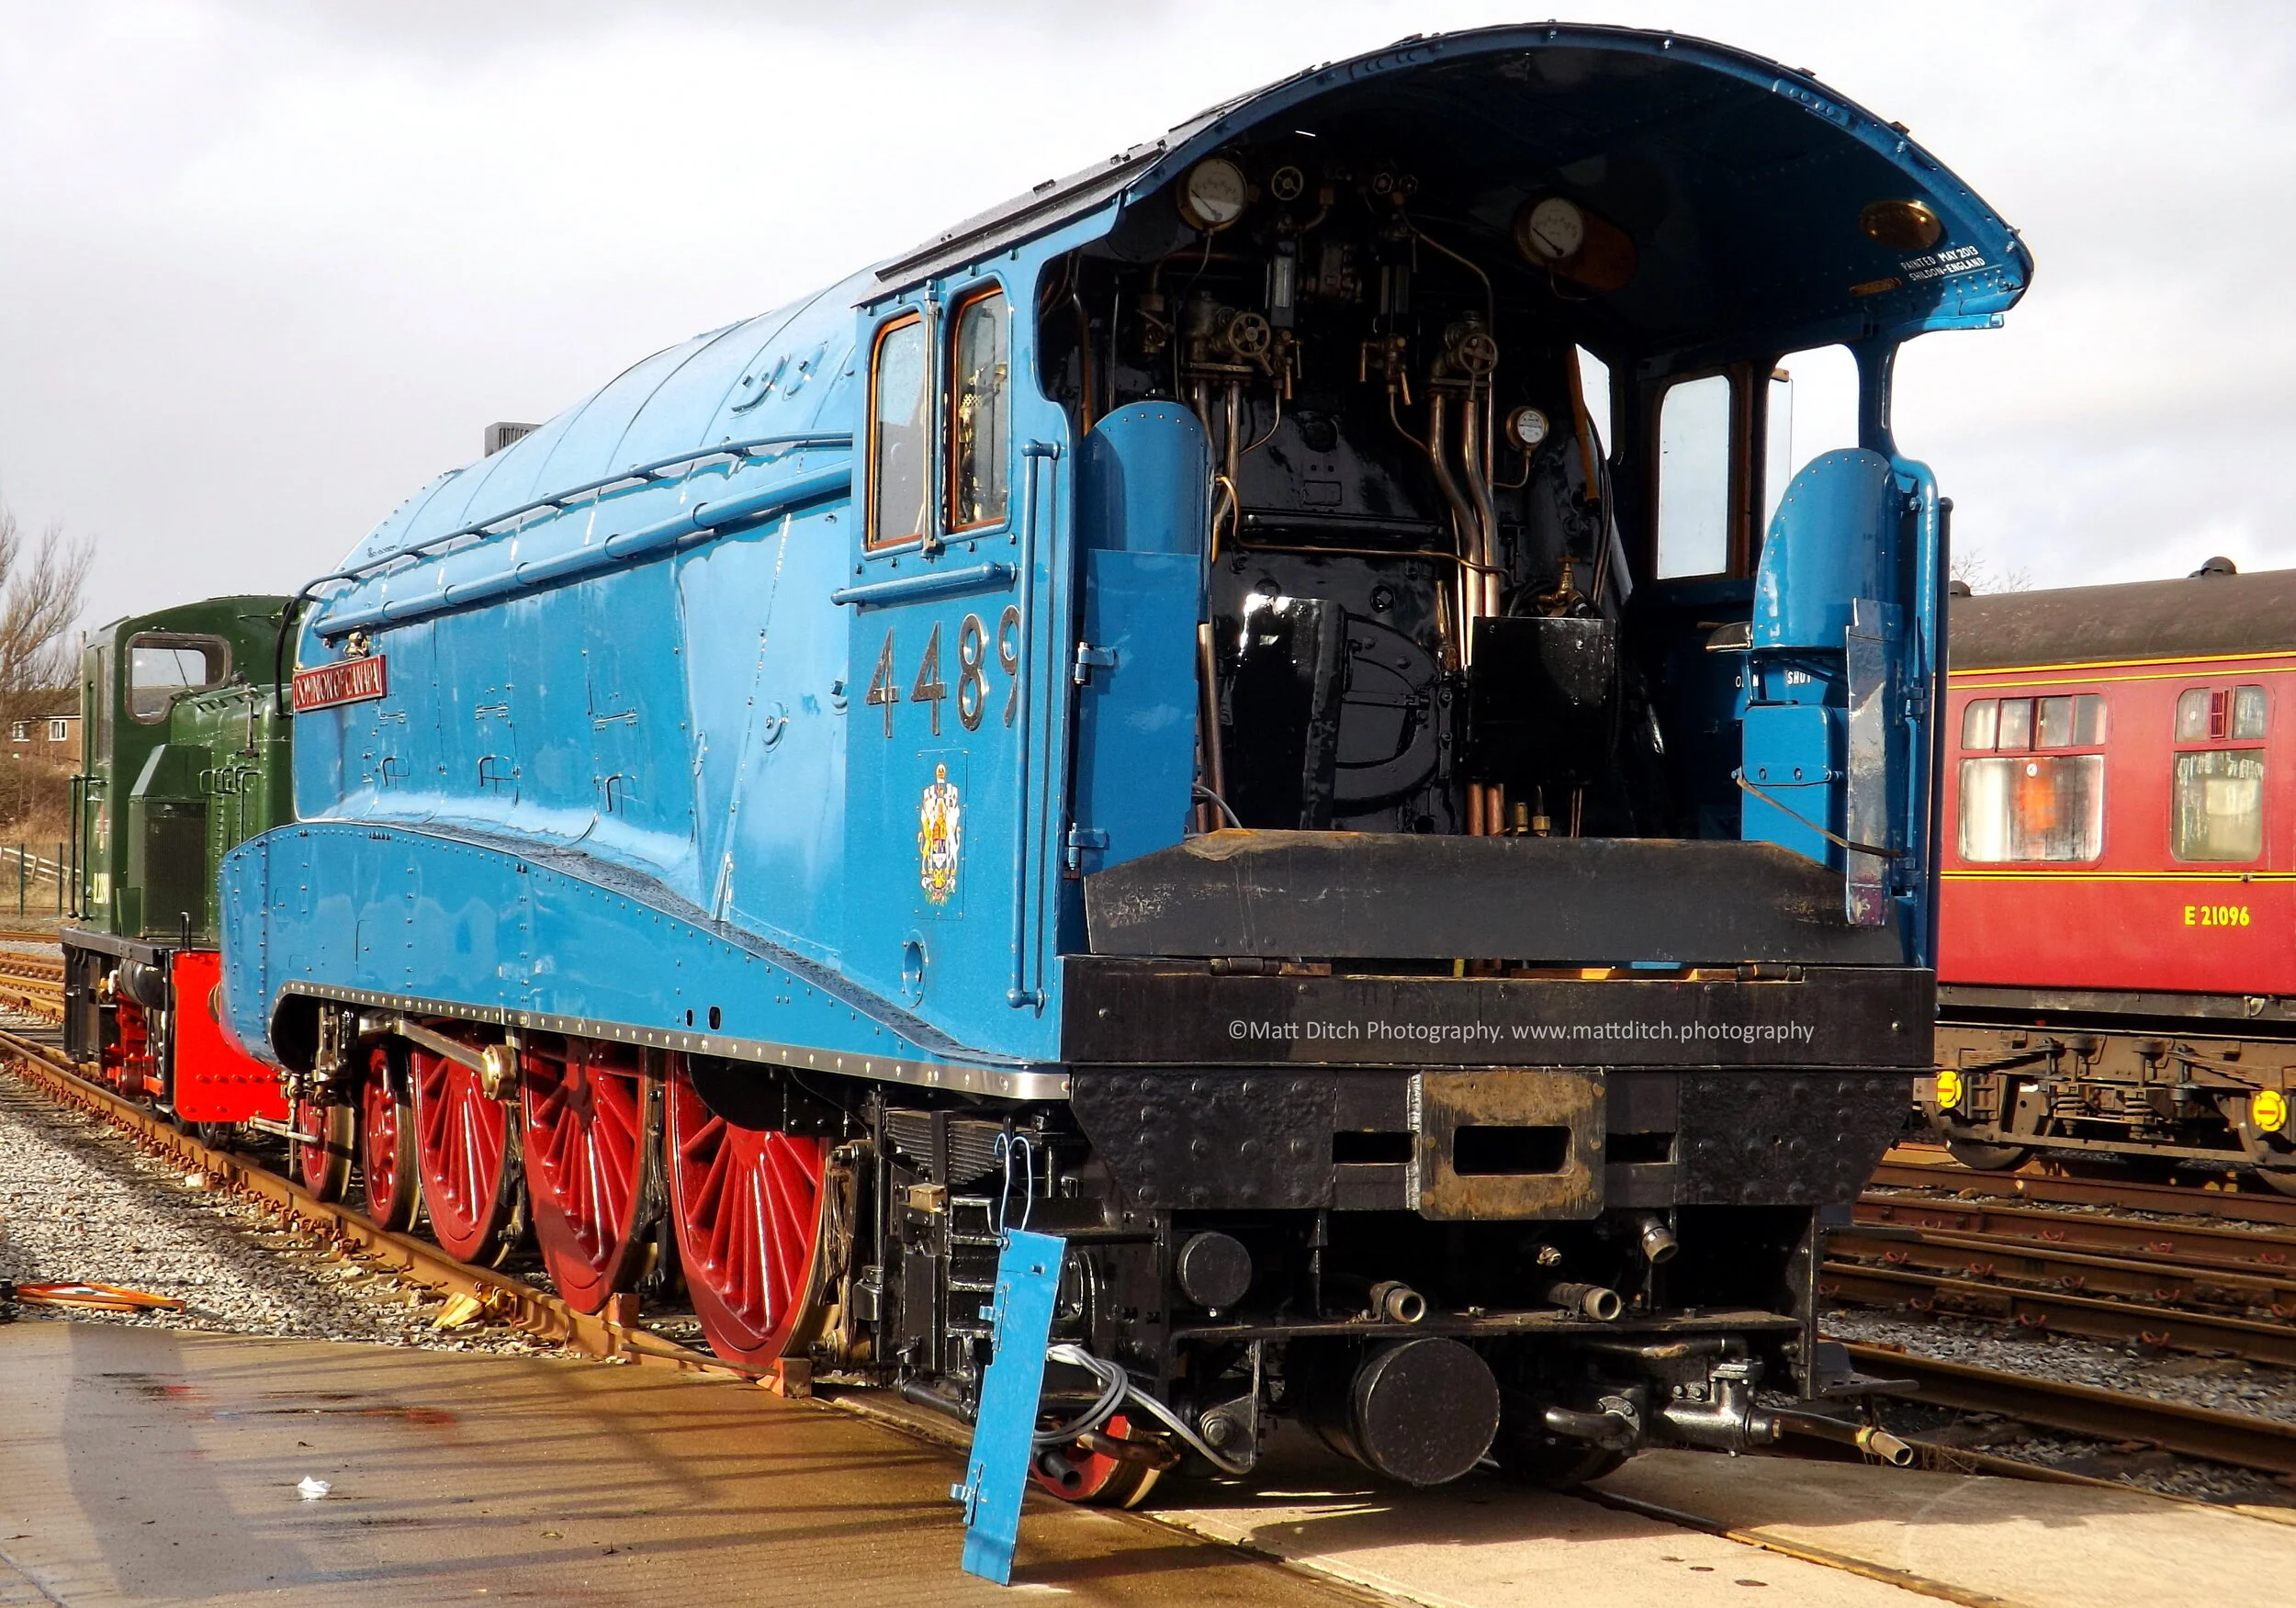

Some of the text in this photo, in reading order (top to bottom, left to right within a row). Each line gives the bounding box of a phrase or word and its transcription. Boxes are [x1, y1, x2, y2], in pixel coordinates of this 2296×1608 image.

[1899, 245, 1979, 271] PAINTED MAY 2013
[333, 669, 344, 698] OF
[865, 604, 1021, 738] 4489
[1735, 674, 1759, 688] ON
[2184, 905, 2250, 927] E 21096
